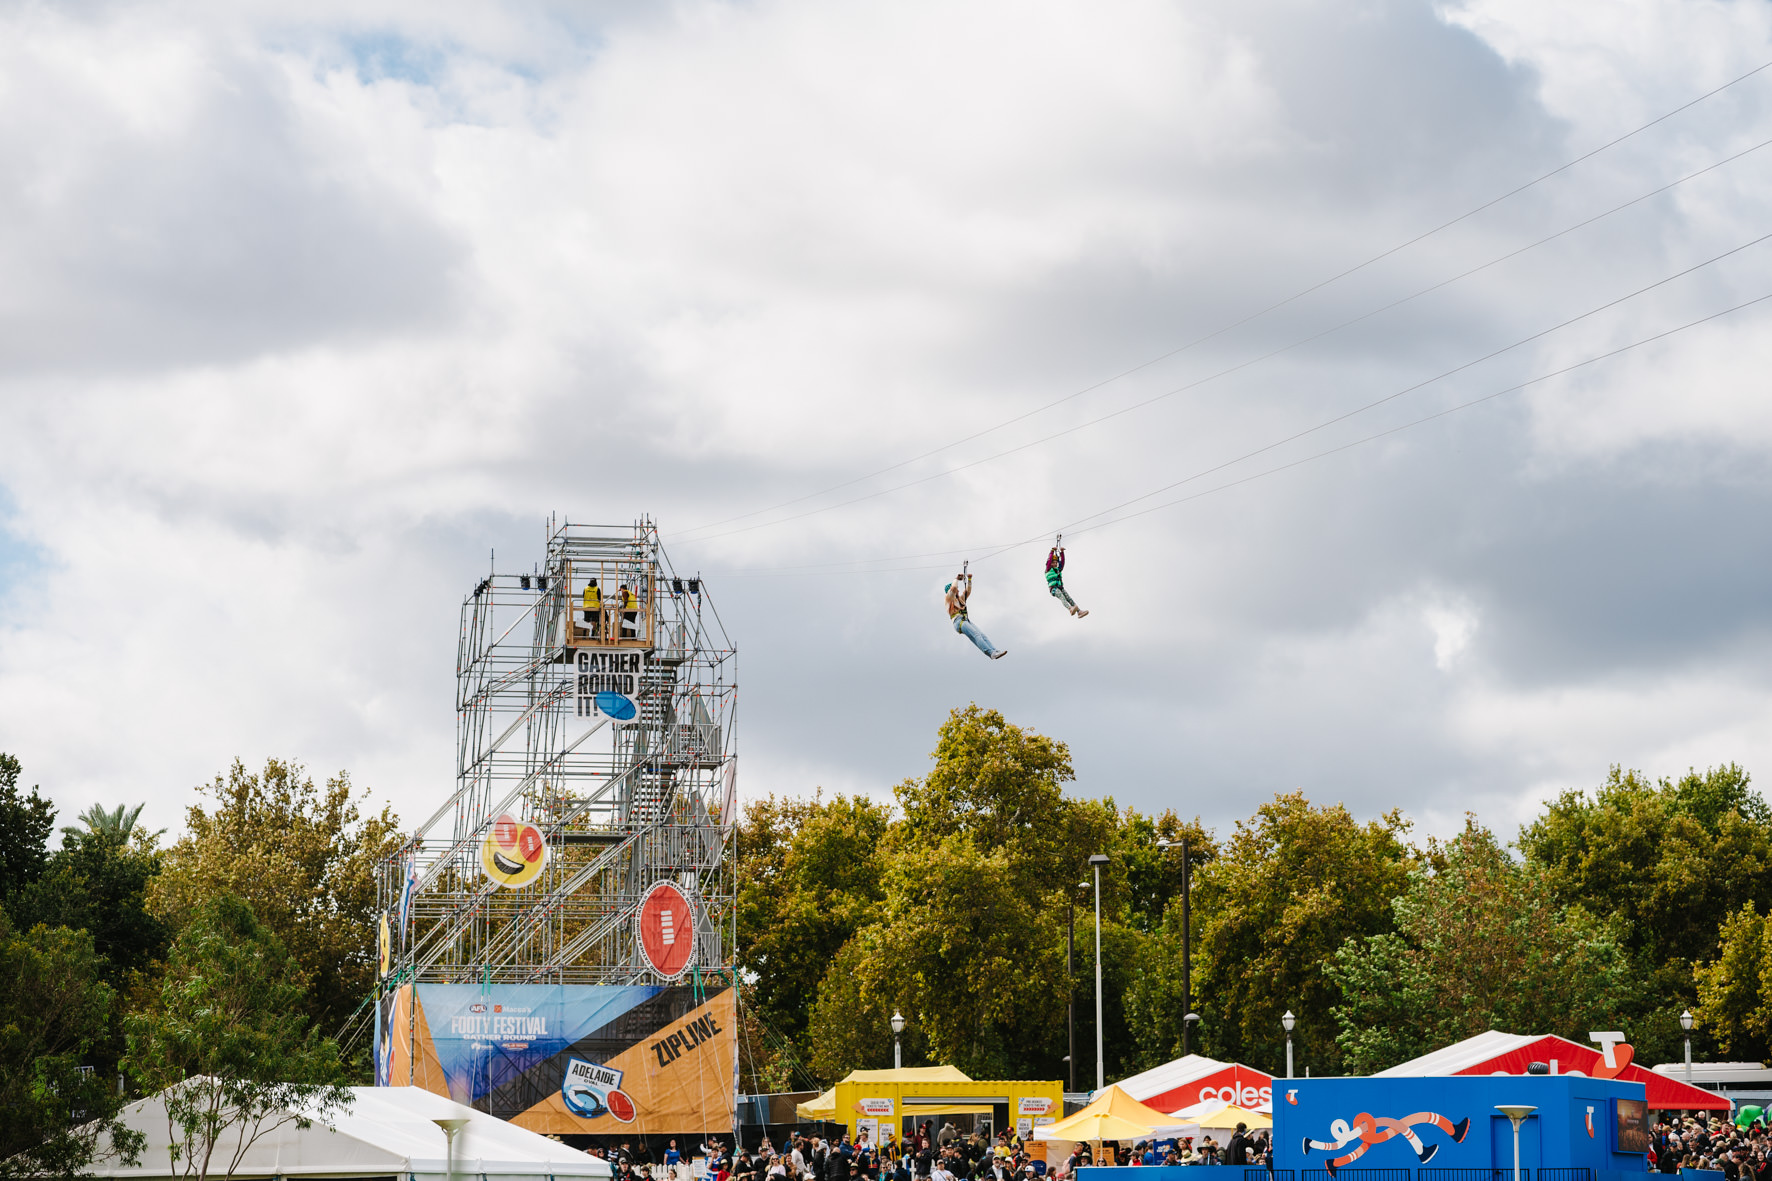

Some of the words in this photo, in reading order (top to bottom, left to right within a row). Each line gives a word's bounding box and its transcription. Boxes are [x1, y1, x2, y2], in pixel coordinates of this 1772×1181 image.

[578, 652, 640, 673] GATHER
[578, 674, 634, 695] ROUND
[451, 1016, 491, 1034] FOOTY
[493, 1016, 548, 1035] FESTIVAL
[650, 1011, 723, 1068] ZIPLINE
[571, 1063, 617, 1086] ADELAIDE
[583, 1078, 599, 1086] OVAL
[1199, 1080, 1273, 1107] coles
